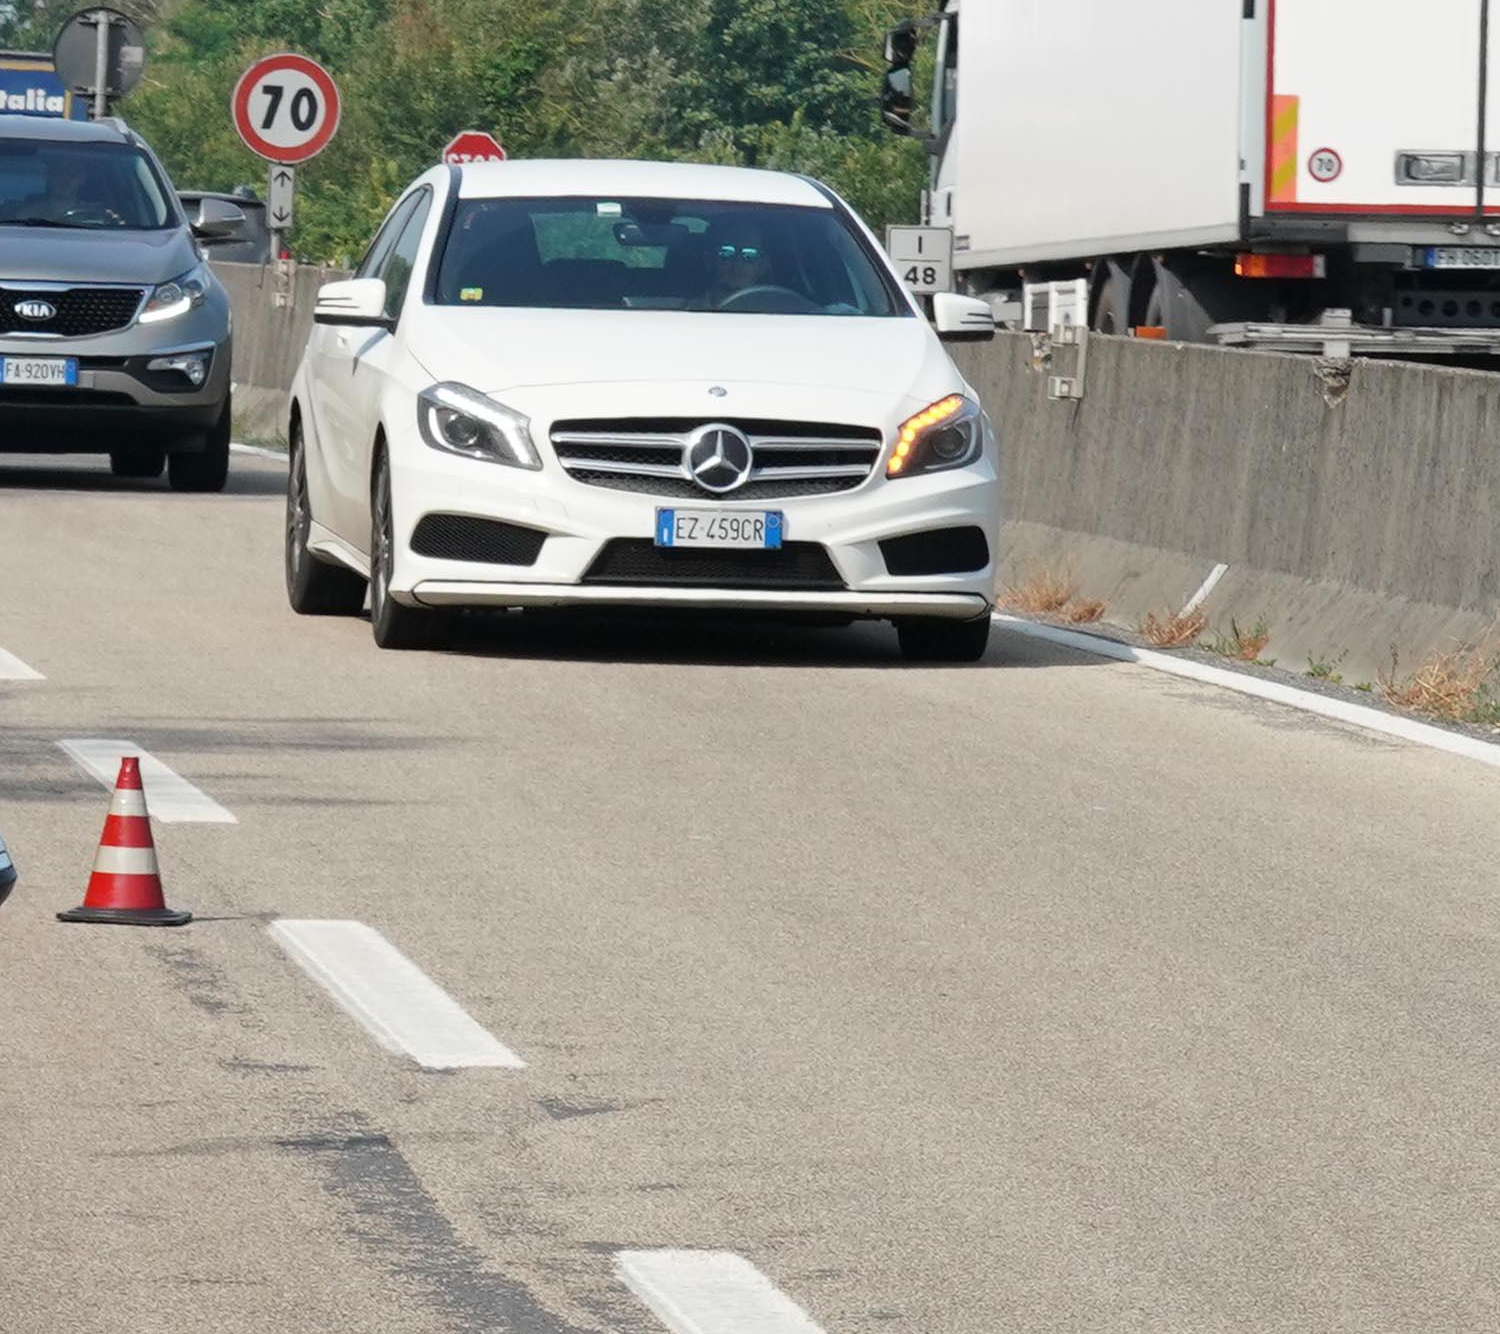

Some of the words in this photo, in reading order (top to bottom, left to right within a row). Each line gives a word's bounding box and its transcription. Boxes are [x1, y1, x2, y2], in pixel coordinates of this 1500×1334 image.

[261, 85, 318, 132] 70
[904, 266, 936, 285] 48
[22, 304, 50, 316] KIA
[676, 517, 698, 540] EZ
